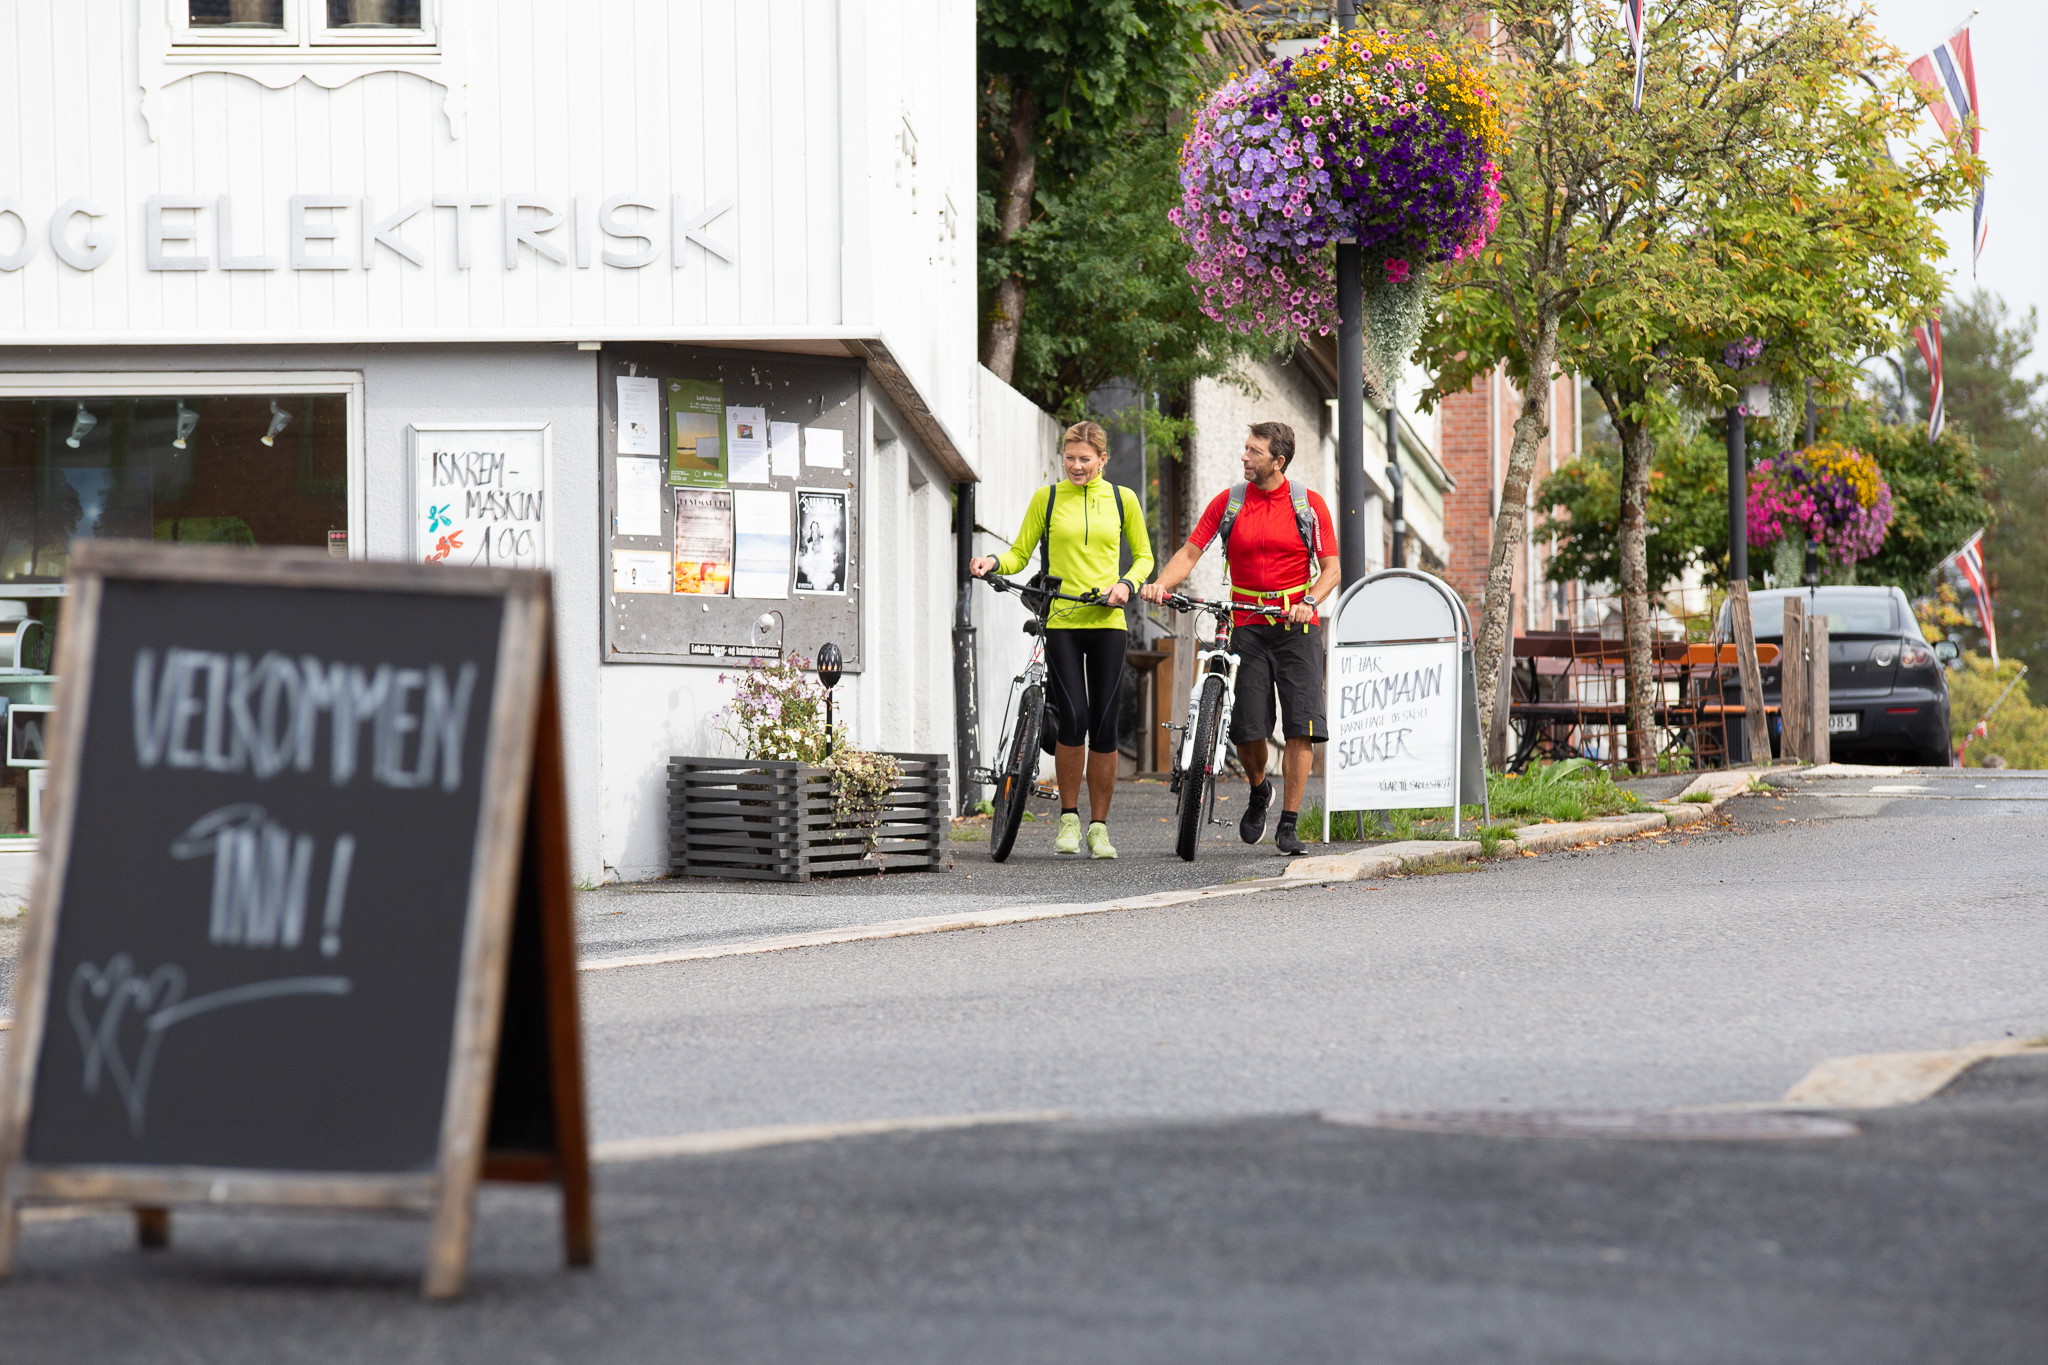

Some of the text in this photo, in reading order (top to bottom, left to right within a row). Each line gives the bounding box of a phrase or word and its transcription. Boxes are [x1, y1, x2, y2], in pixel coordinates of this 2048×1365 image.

[145, 193, 736, 272] ELEKTRISK
[465, 489, 543, 522] MASKIN
[1359, 656, 1383, 673] HAR
[1340, 663, 1442, 719] BECKMANN
[132, 647, 479, 792] VELKOMMEN
[1338, 728, 1420, 770] SEKKER
